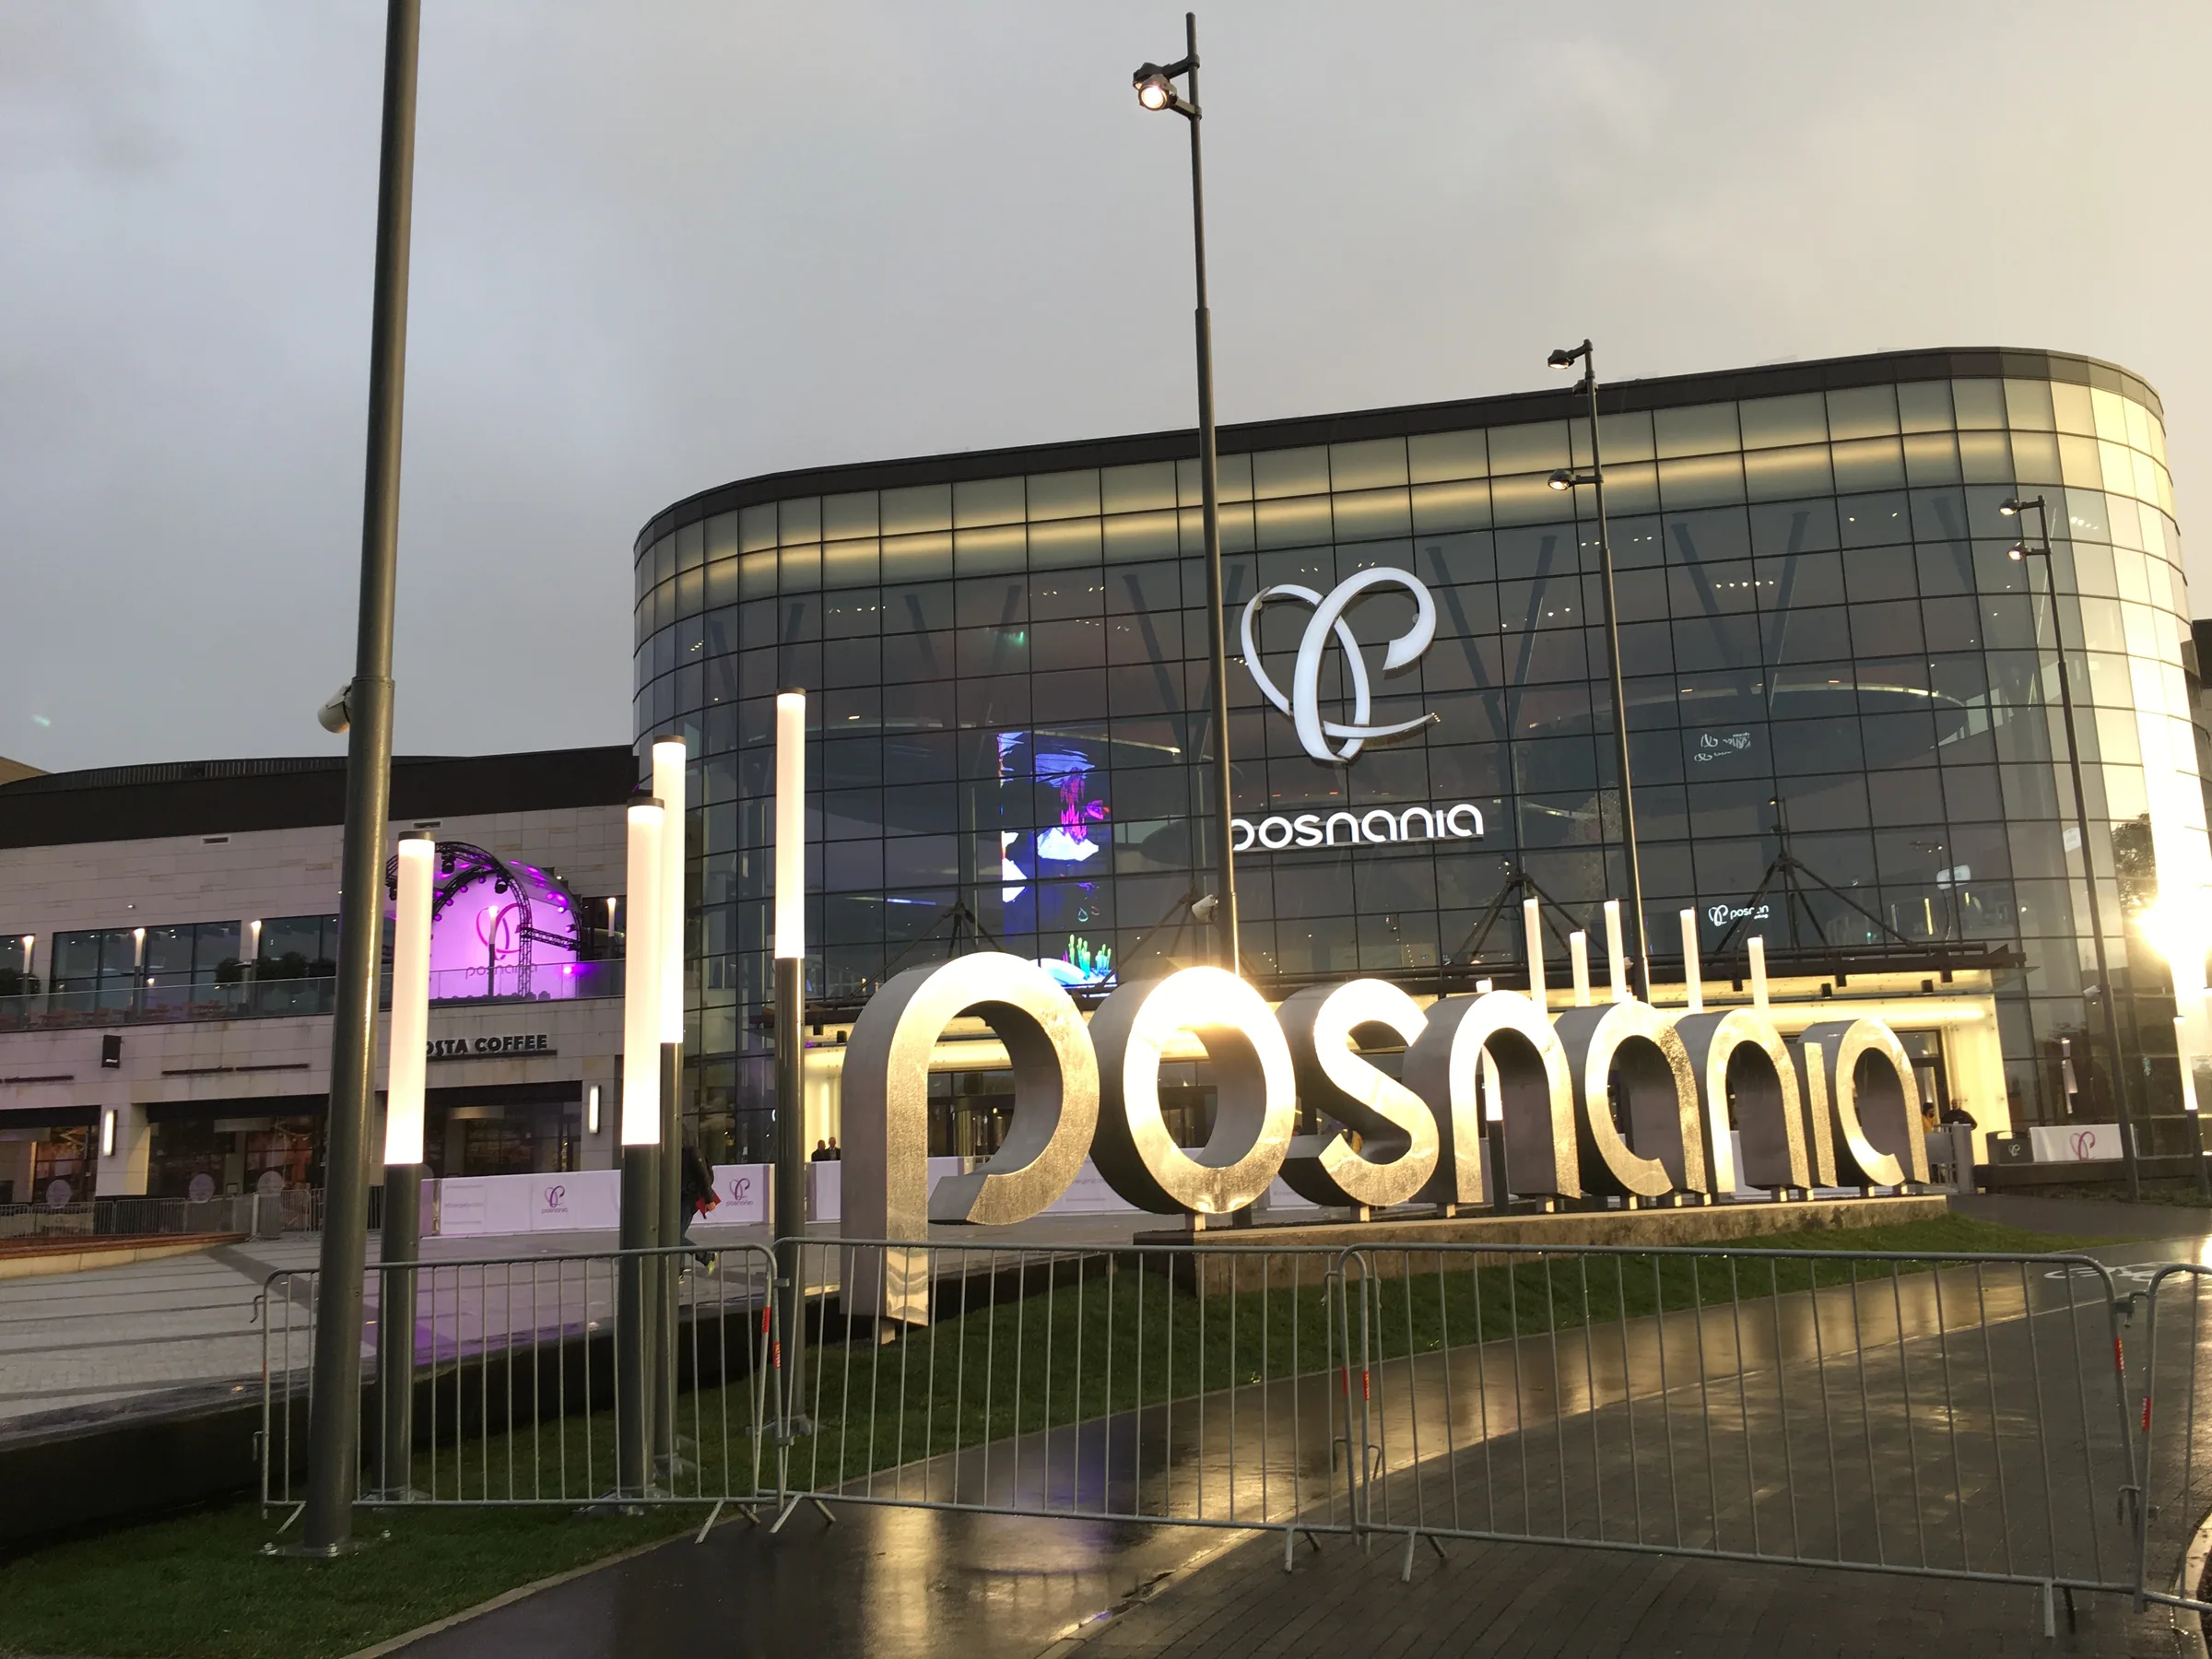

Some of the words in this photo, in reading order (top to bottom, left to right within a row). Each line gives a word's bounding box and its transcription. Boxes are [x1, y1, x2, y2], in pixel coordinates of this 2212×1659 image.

[426, 1039, 468, 1056] OSTA
[475, 1034, 547, 1053] COFFEE
[840, 950, 1931, 1326] posnania
